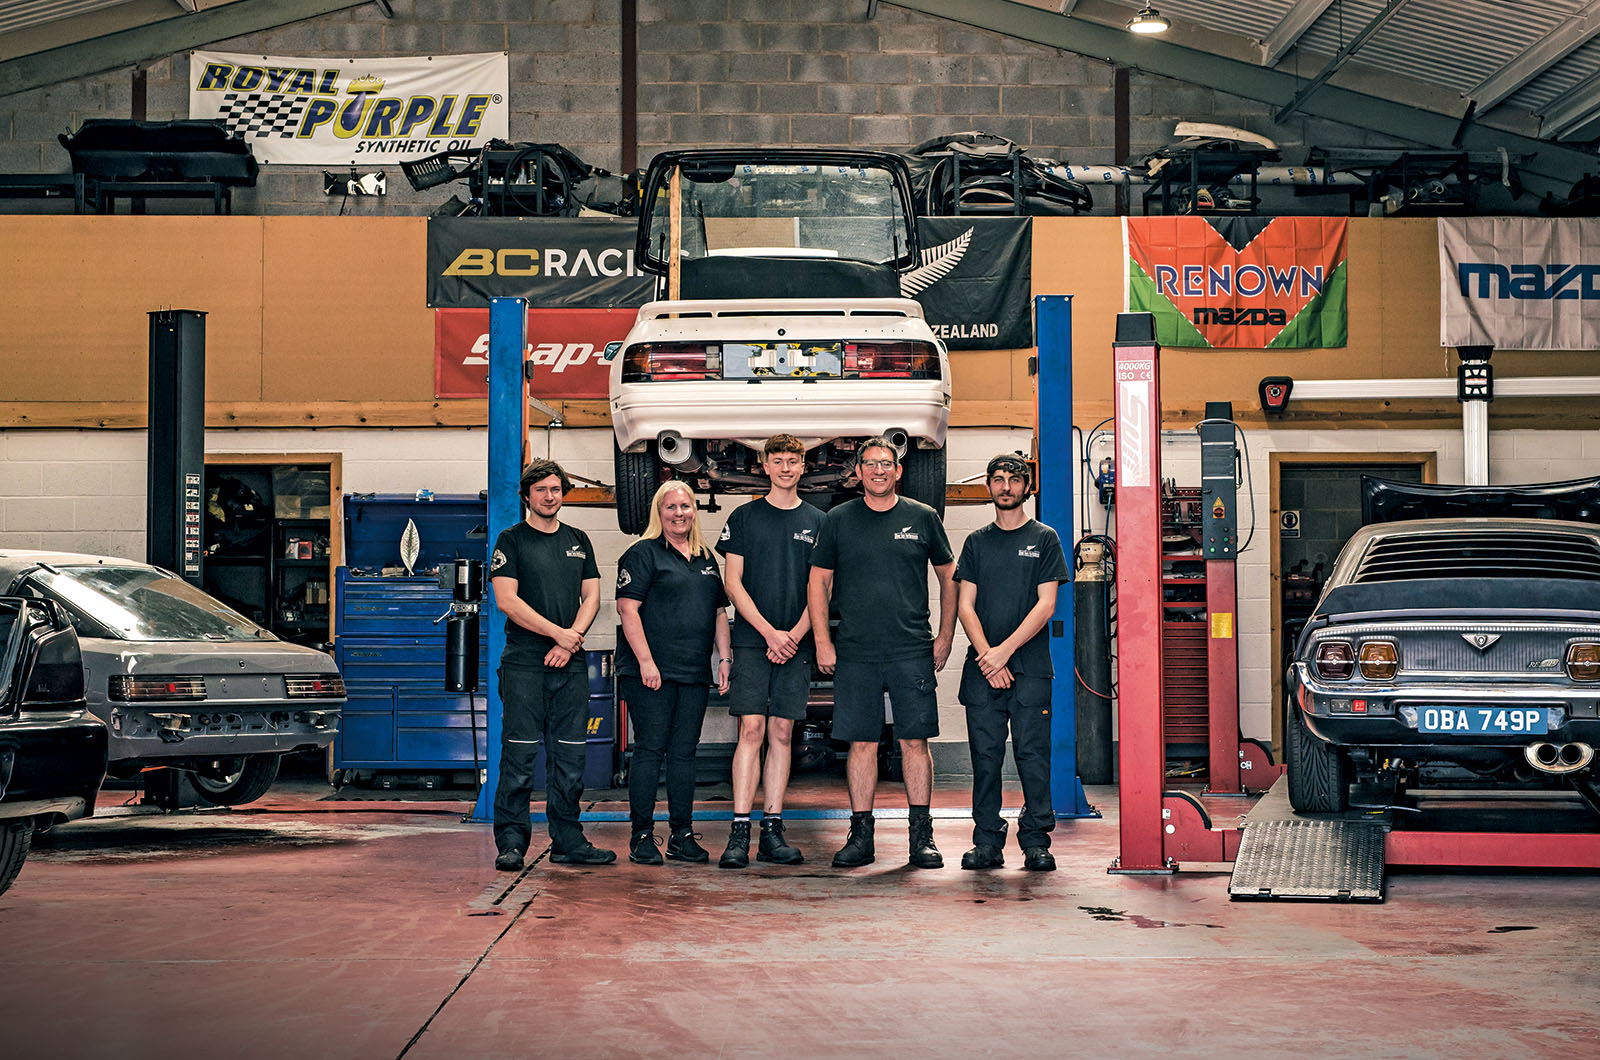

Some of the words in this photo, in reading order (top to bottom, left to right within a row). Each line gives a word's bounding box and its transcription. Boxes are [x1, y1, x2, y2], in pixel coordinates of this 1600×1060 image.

[196, 62, 340, 96] ROYAL
[296, 94, 493, 139] PURPLE
[355, 140, 440, 153] SYNTHETIC
[544, 249, 689, 276] RACI
[1155, 264, 1323, 297] RENOWN
[931, 323, 998, 339] ZEALAND
[1118, 362, 1151, 370] 4000KG
[1424, 709, 1470, 730] OBA
[1478, 710, 1540, 731] 749P
